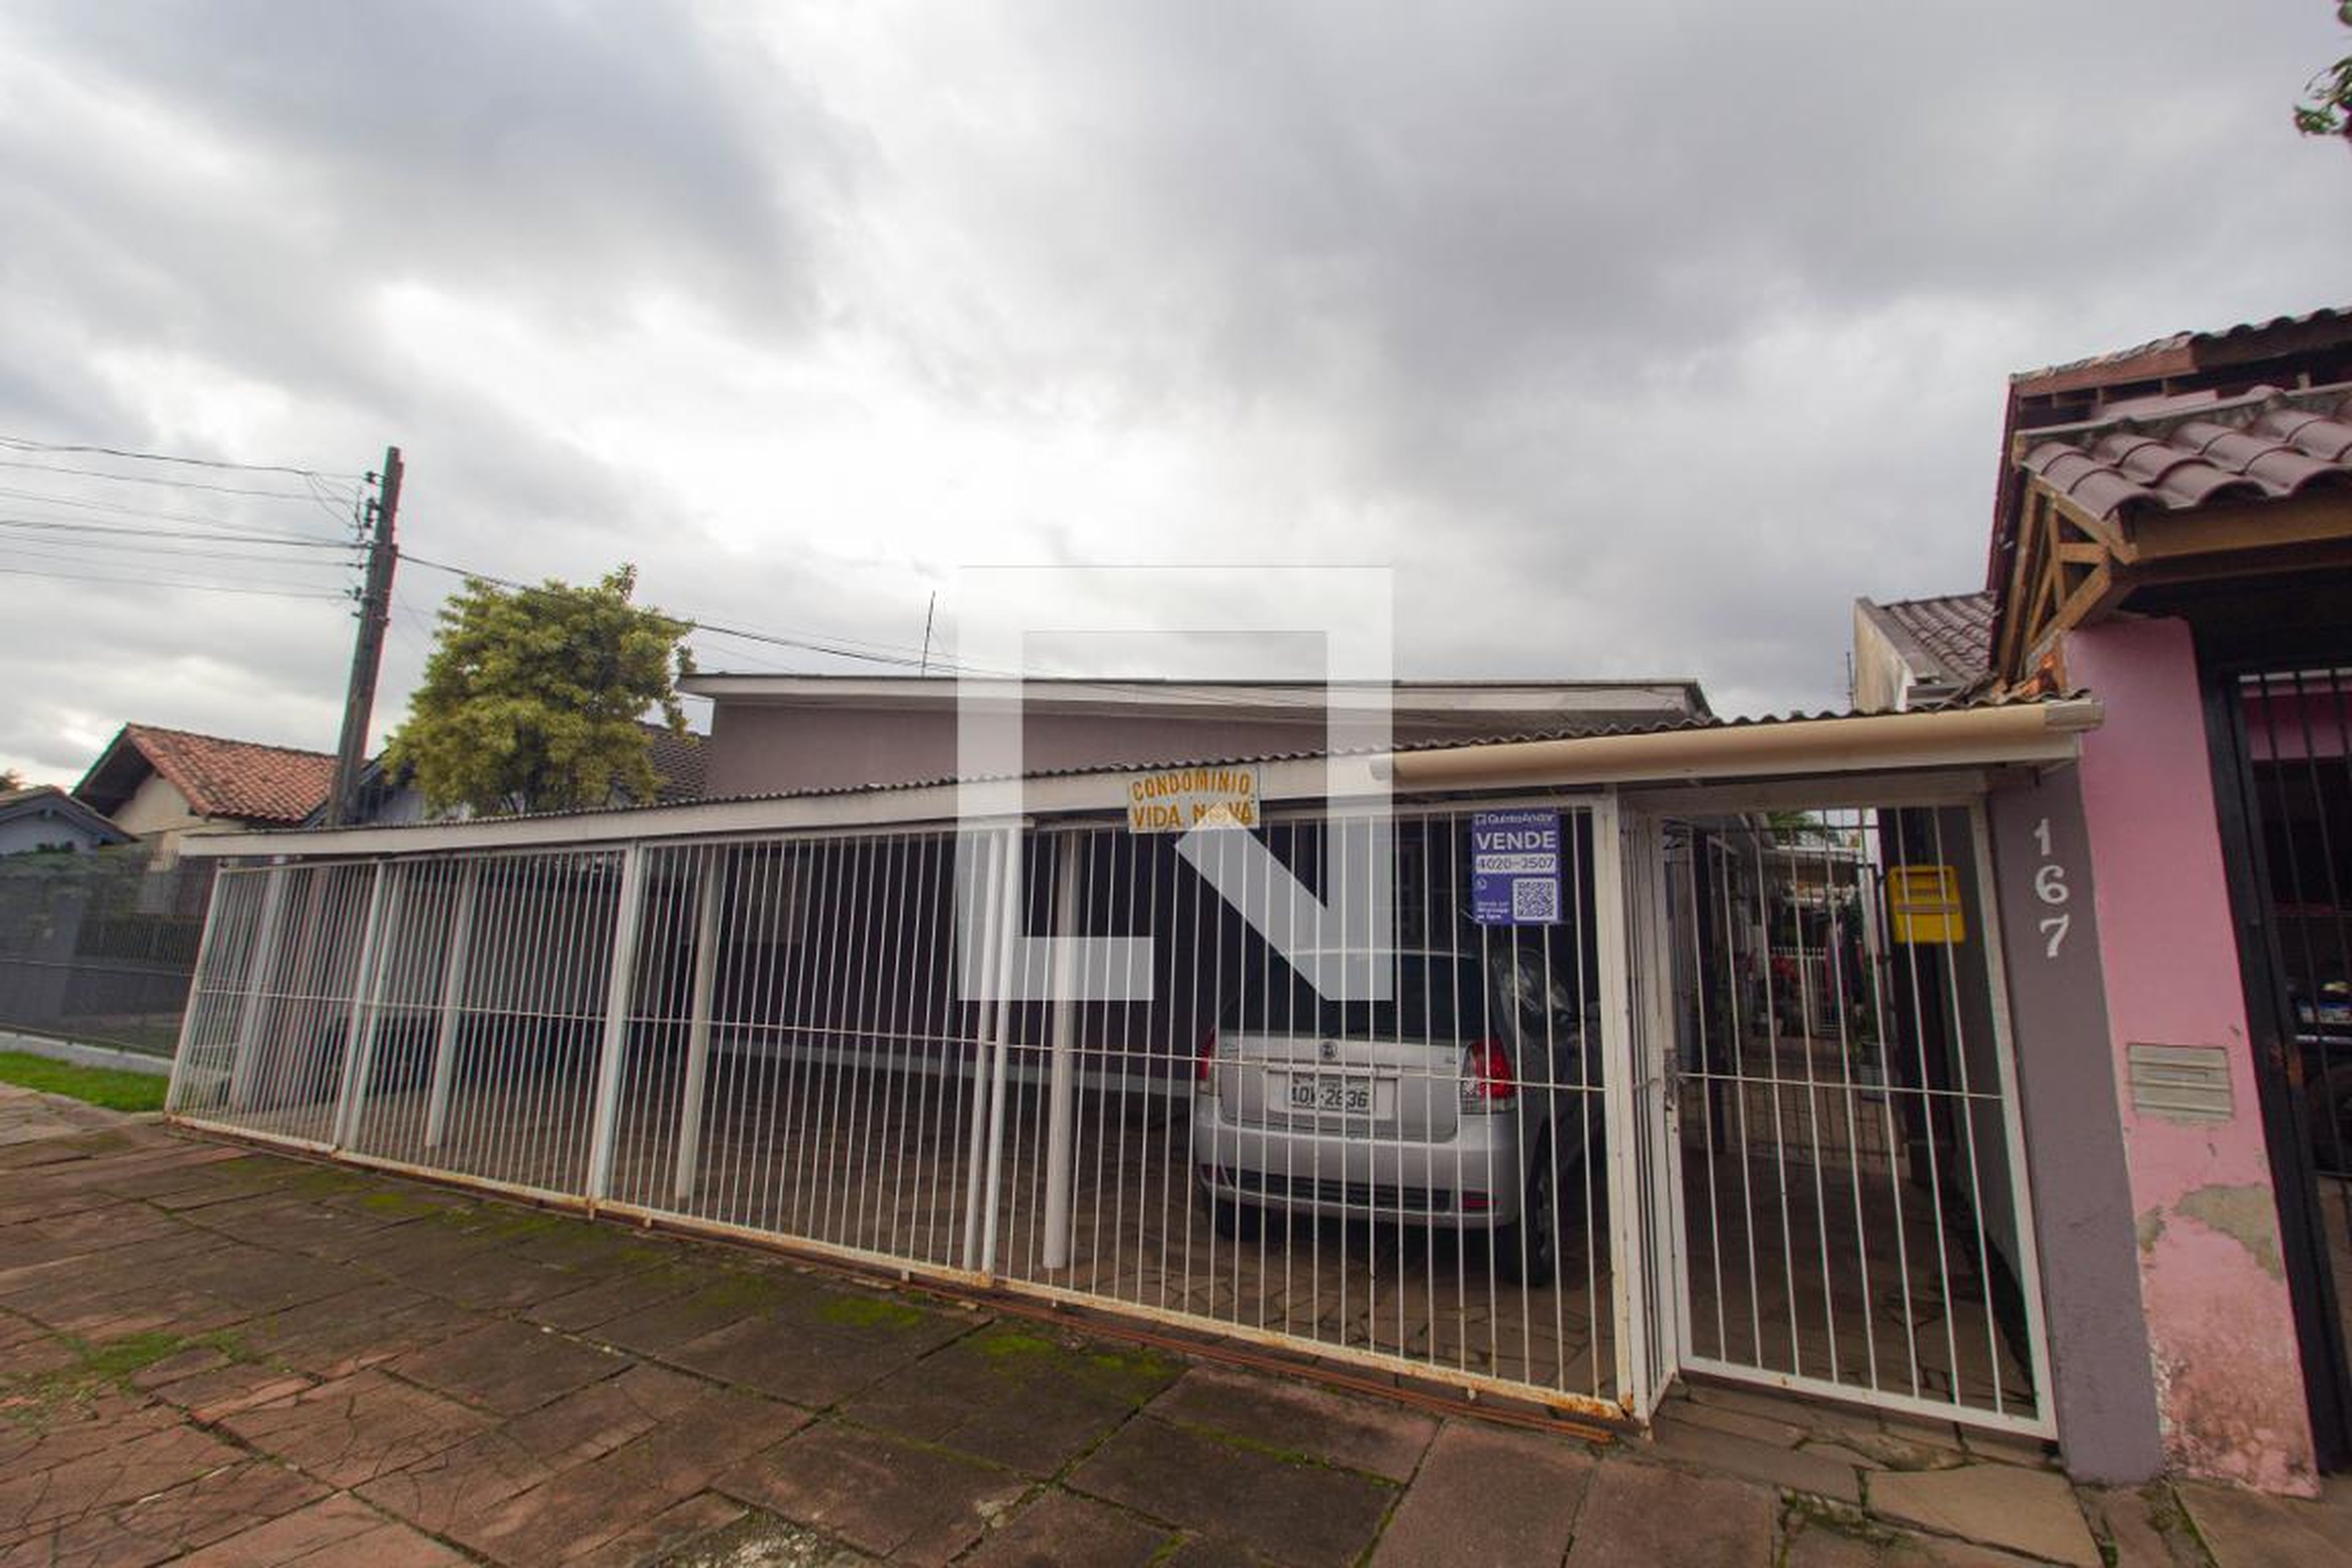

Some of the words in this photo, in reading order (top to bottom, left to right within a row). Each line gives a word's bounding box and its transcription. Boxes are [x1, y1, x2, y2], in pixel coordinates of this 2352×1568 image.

[1132, 769, 1251, 801] CONDOMINIO
[1134, 804, 1180, 827] VIDA
[1476, 831, 1556, 850] VENDE
[2033, 818, 2070, 958] 167
